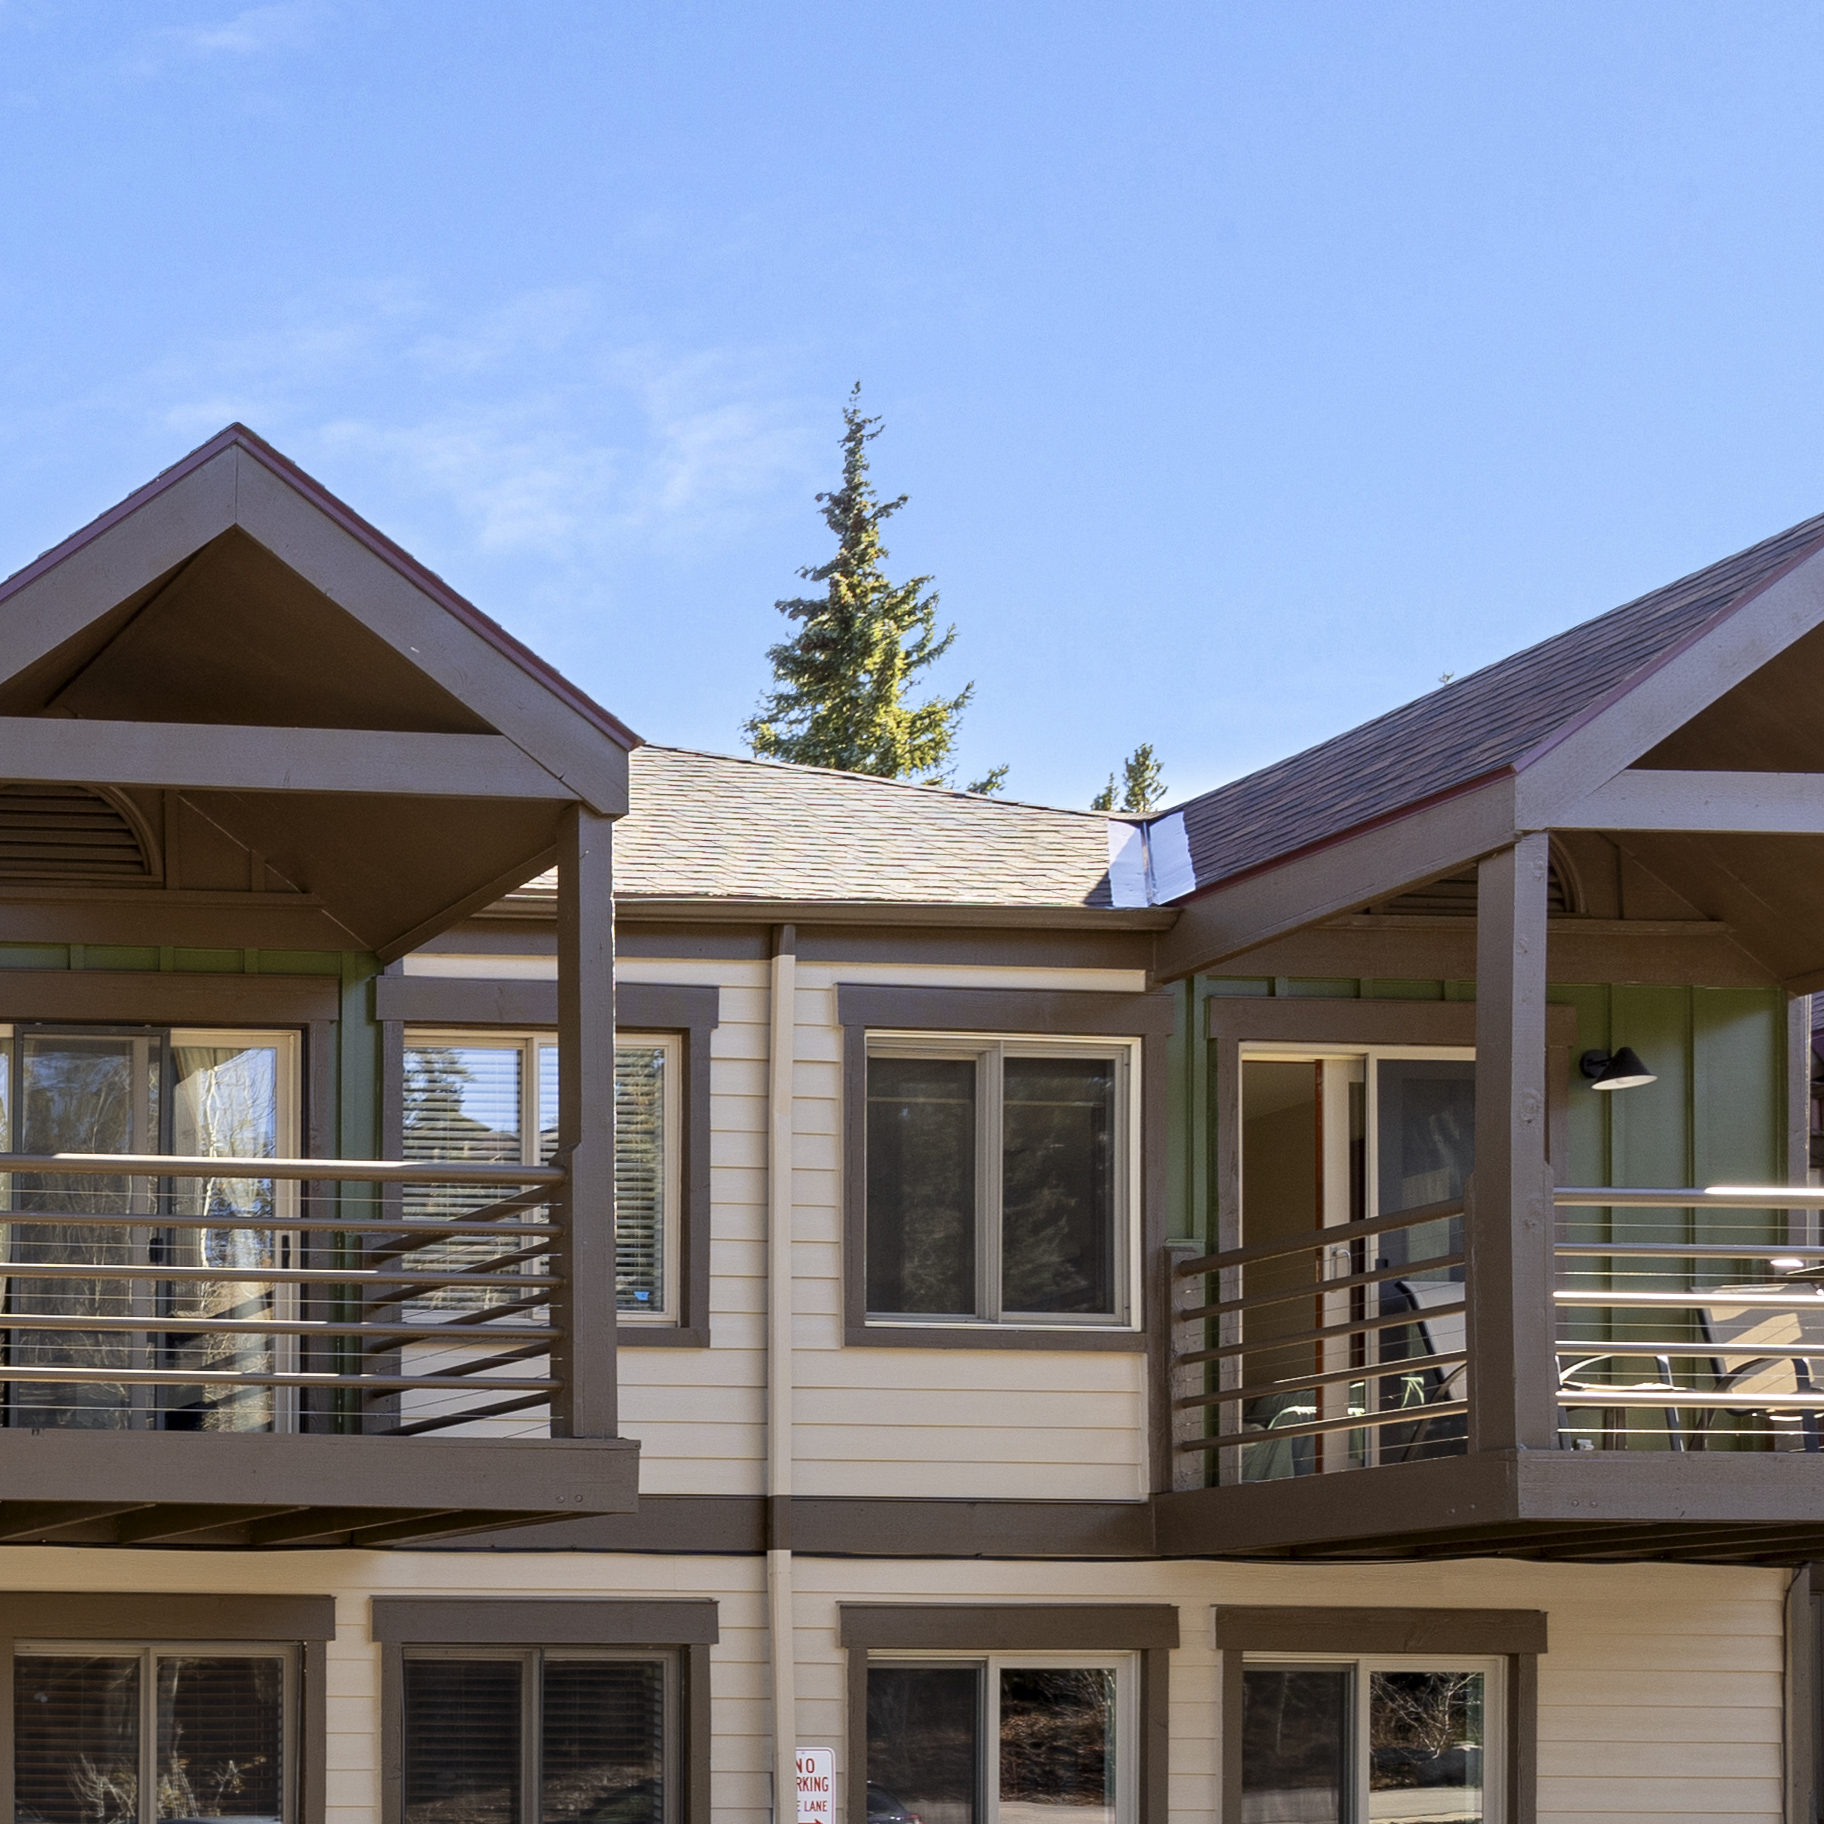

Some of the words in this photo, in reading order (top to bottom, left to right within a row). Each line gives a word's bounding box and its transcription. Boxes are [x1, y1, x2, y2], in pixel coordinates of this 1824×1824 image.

[796, 1758, 815, 1774] NO
[796, 1776, 829, 1792] RKING
[804, 1800, 828, 1812] LANE
